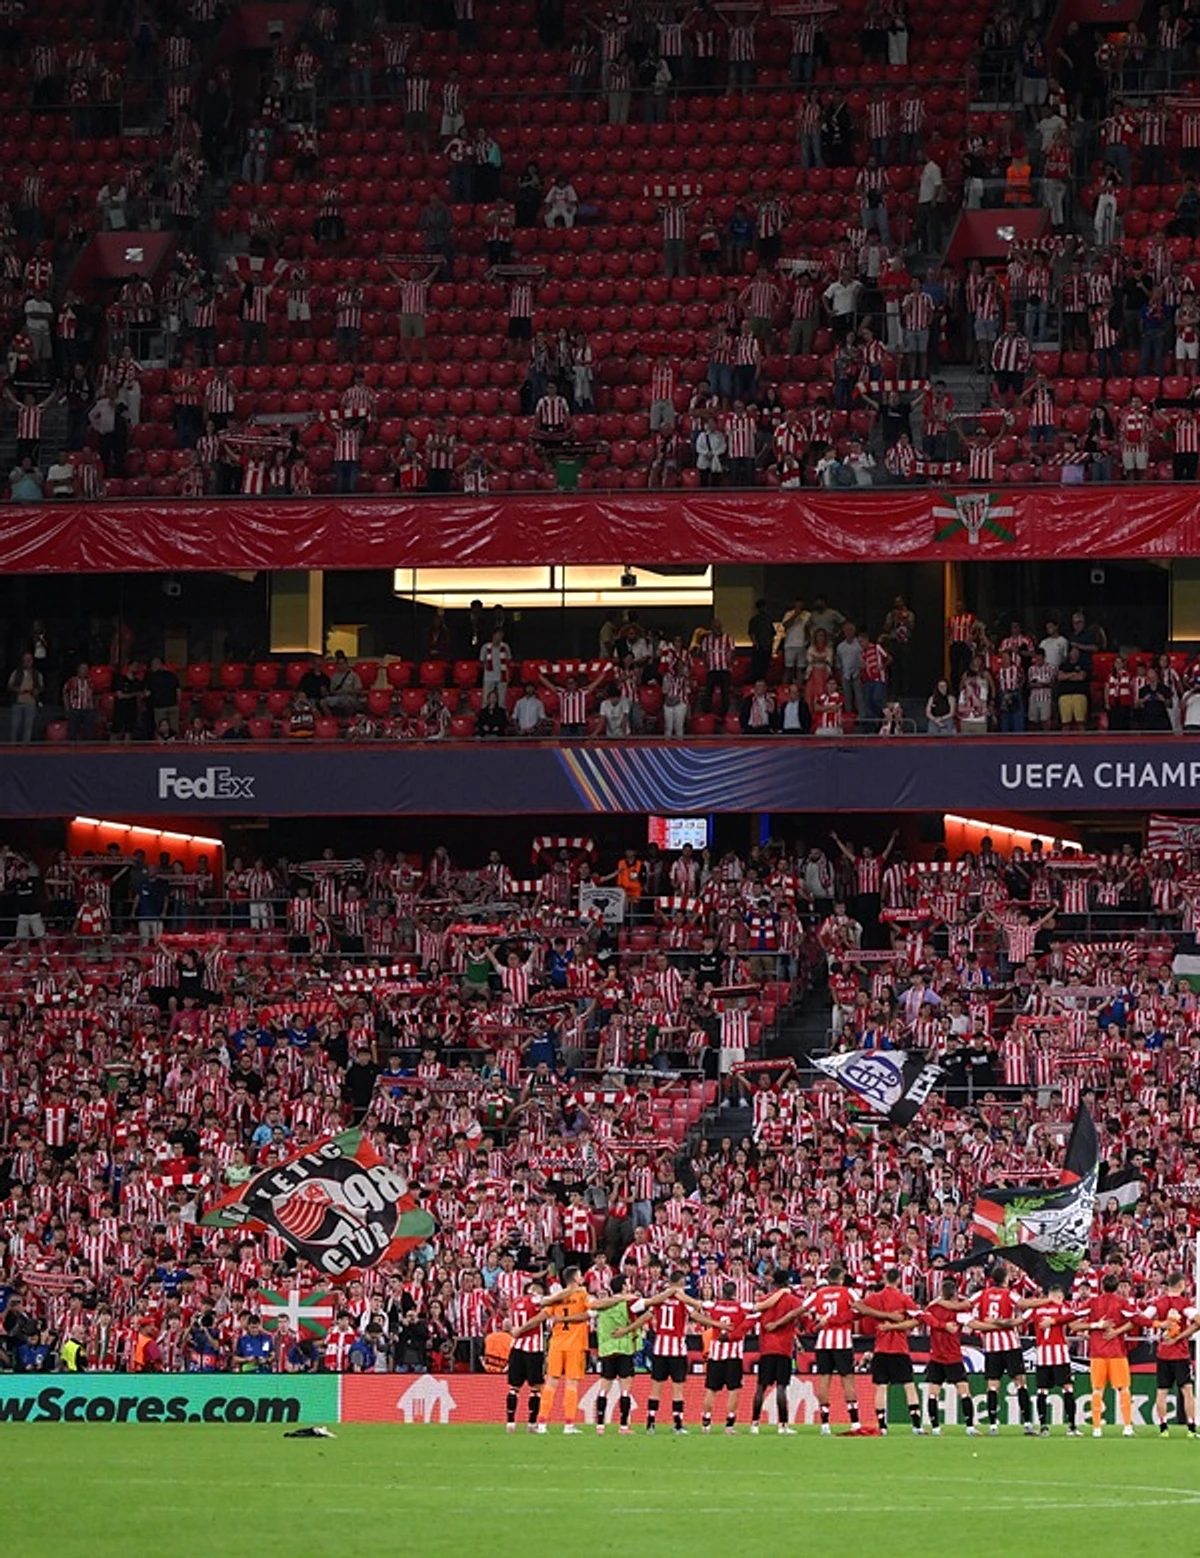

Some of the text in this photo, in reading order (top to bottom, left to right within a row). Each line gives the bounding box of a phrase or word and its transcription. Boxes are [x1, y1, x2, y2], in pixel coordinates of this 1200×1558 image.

[158, 766, 255, 799] FedEx
[1001, 763, 1084, 788] UEFA
[342, 1165, 408, 1212] 98
[659, 1305, 675, 1330] 11
